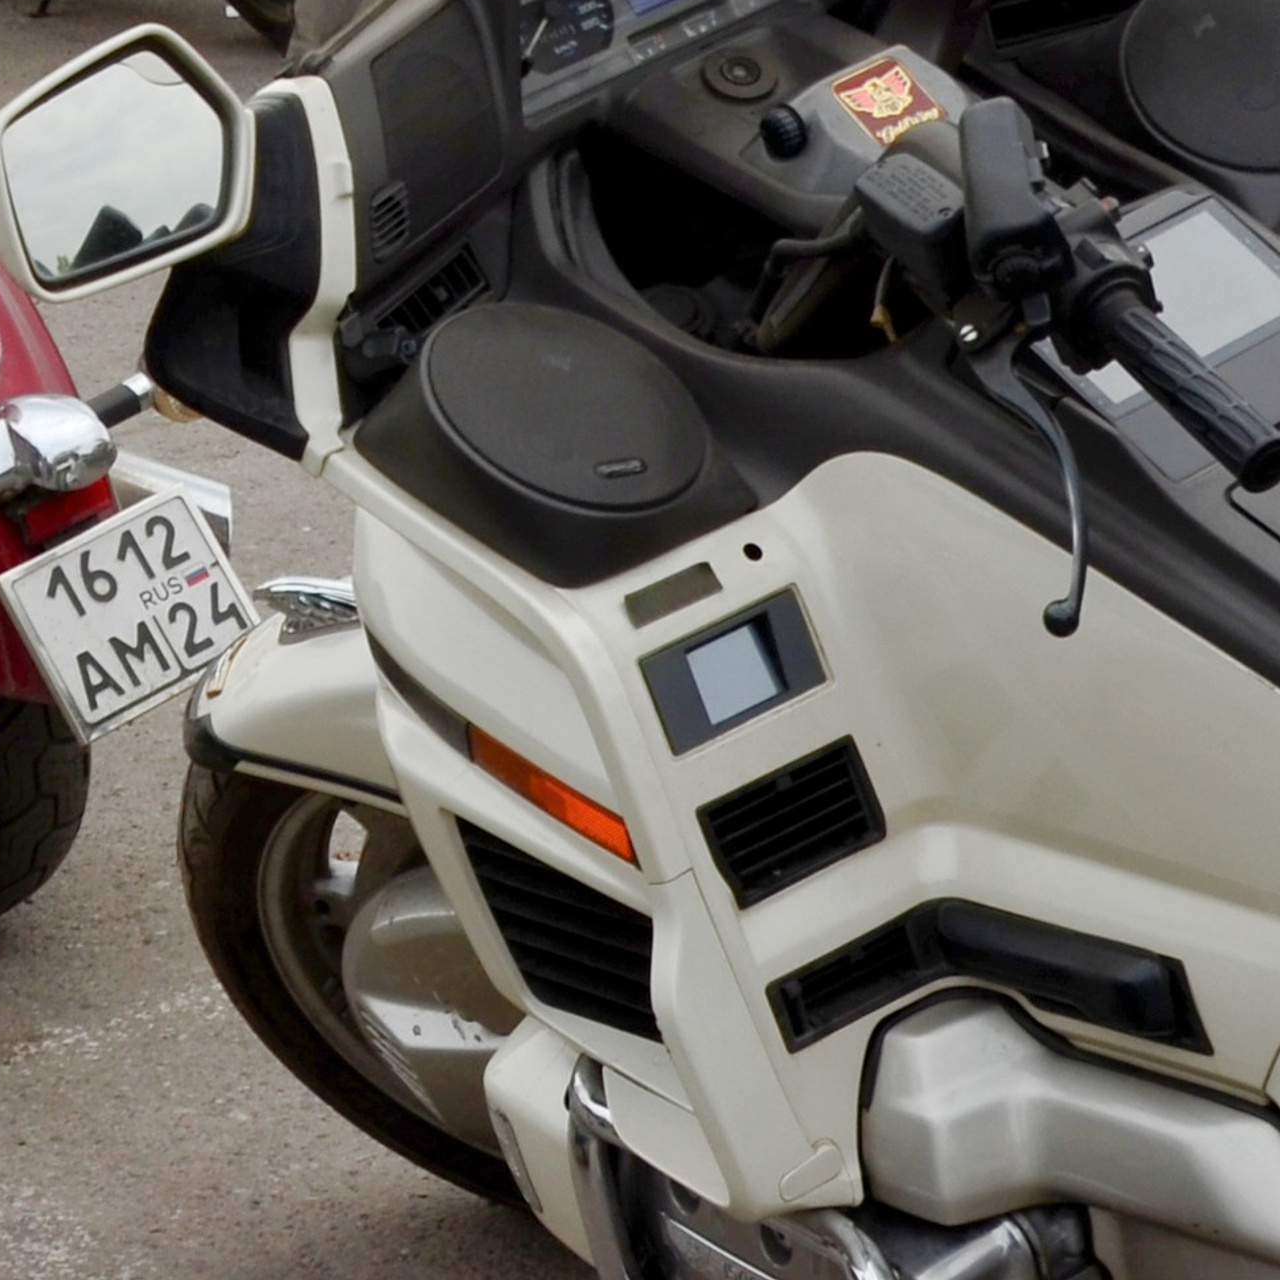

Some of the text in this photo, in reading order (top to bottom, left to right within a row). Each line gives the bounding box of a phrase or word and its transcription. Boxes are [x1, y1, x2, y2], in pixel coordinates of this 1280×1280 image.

[46, 515, 192, 618] 1612
[138, 575, 184, 611] RUS
[76, 581, 248, 712] AM 24
